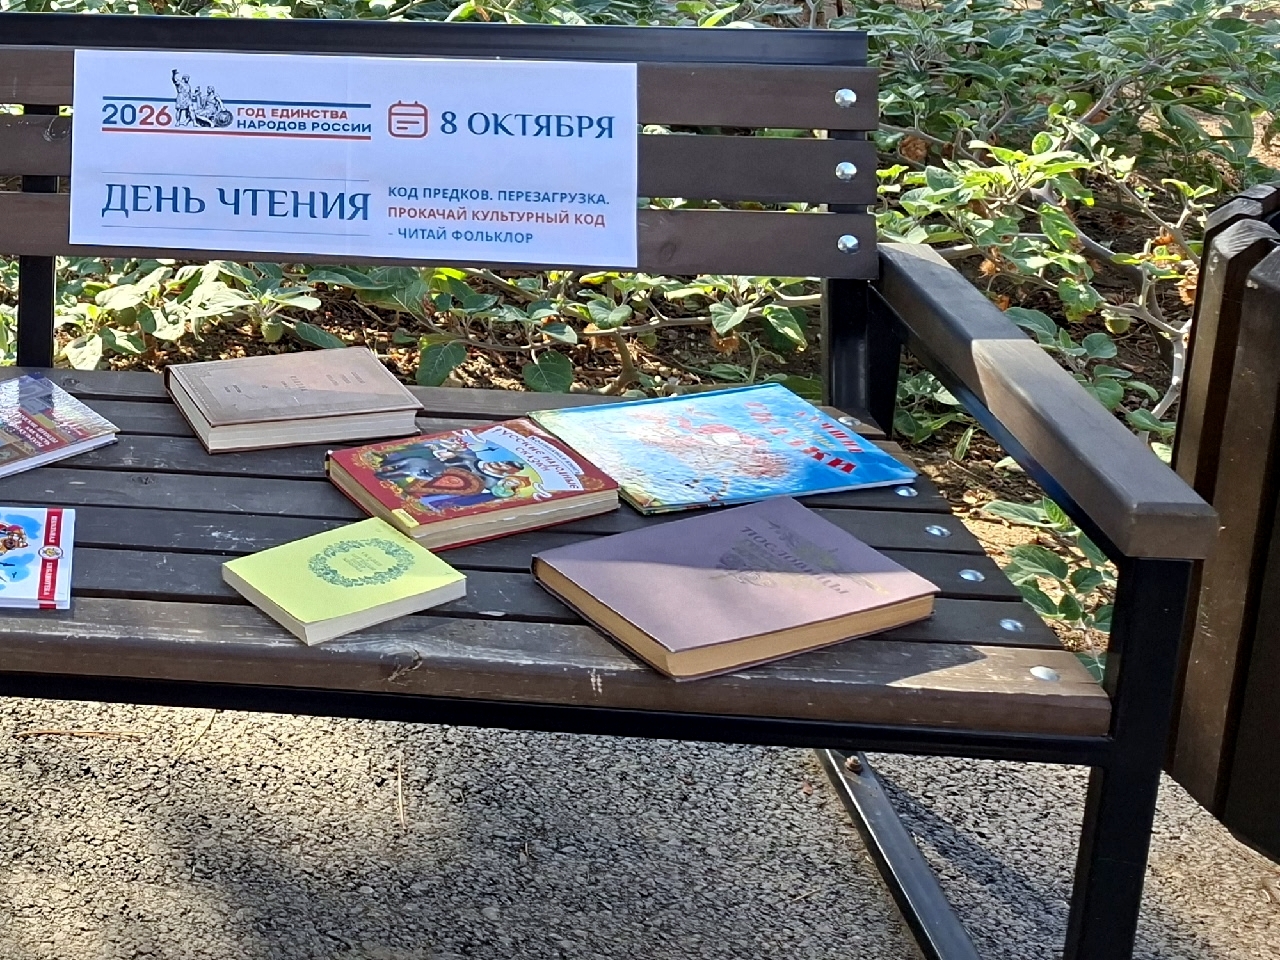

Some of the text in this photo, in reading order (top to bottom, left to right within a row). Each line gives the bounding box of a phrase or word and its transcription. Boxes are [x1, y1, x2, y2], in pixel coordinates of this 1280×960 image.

[101, 103, 173, 127] 2026
[237, 107, 349, 120] ГОД ЕДИНСТВА
[237, 119, 372, 133] НАРОДОВ РОССИИ
[439, 110, 616, 139] 8 ОКТЯБРЯ
[101, 183, 371, 221] ДЕНЬ ЧТЕНИЯ
[388, 186, 610, 205] КОД ПРЕДКОВ. ПЕРЕЗАГРУЗКА.
[388, 206, 606, 228] ПРОКАЧАЙ КУЛЬТУРНЫЙ КОД
[397, 227, 447, 241] ЧИТАЙ
[451, 230, 534, 244] ФОЛЬКЛОР
[743, 401, 857, 474] СКАЗКИ
[491, 427, 545, 456] РУССКИЕ
[543, 452, 580, 490] НАРОДНЫЕ
[515, 446, 552, 473] СКАЗКИ
[741, 526, 850, 595] ПОСЛОВИЦЫ
